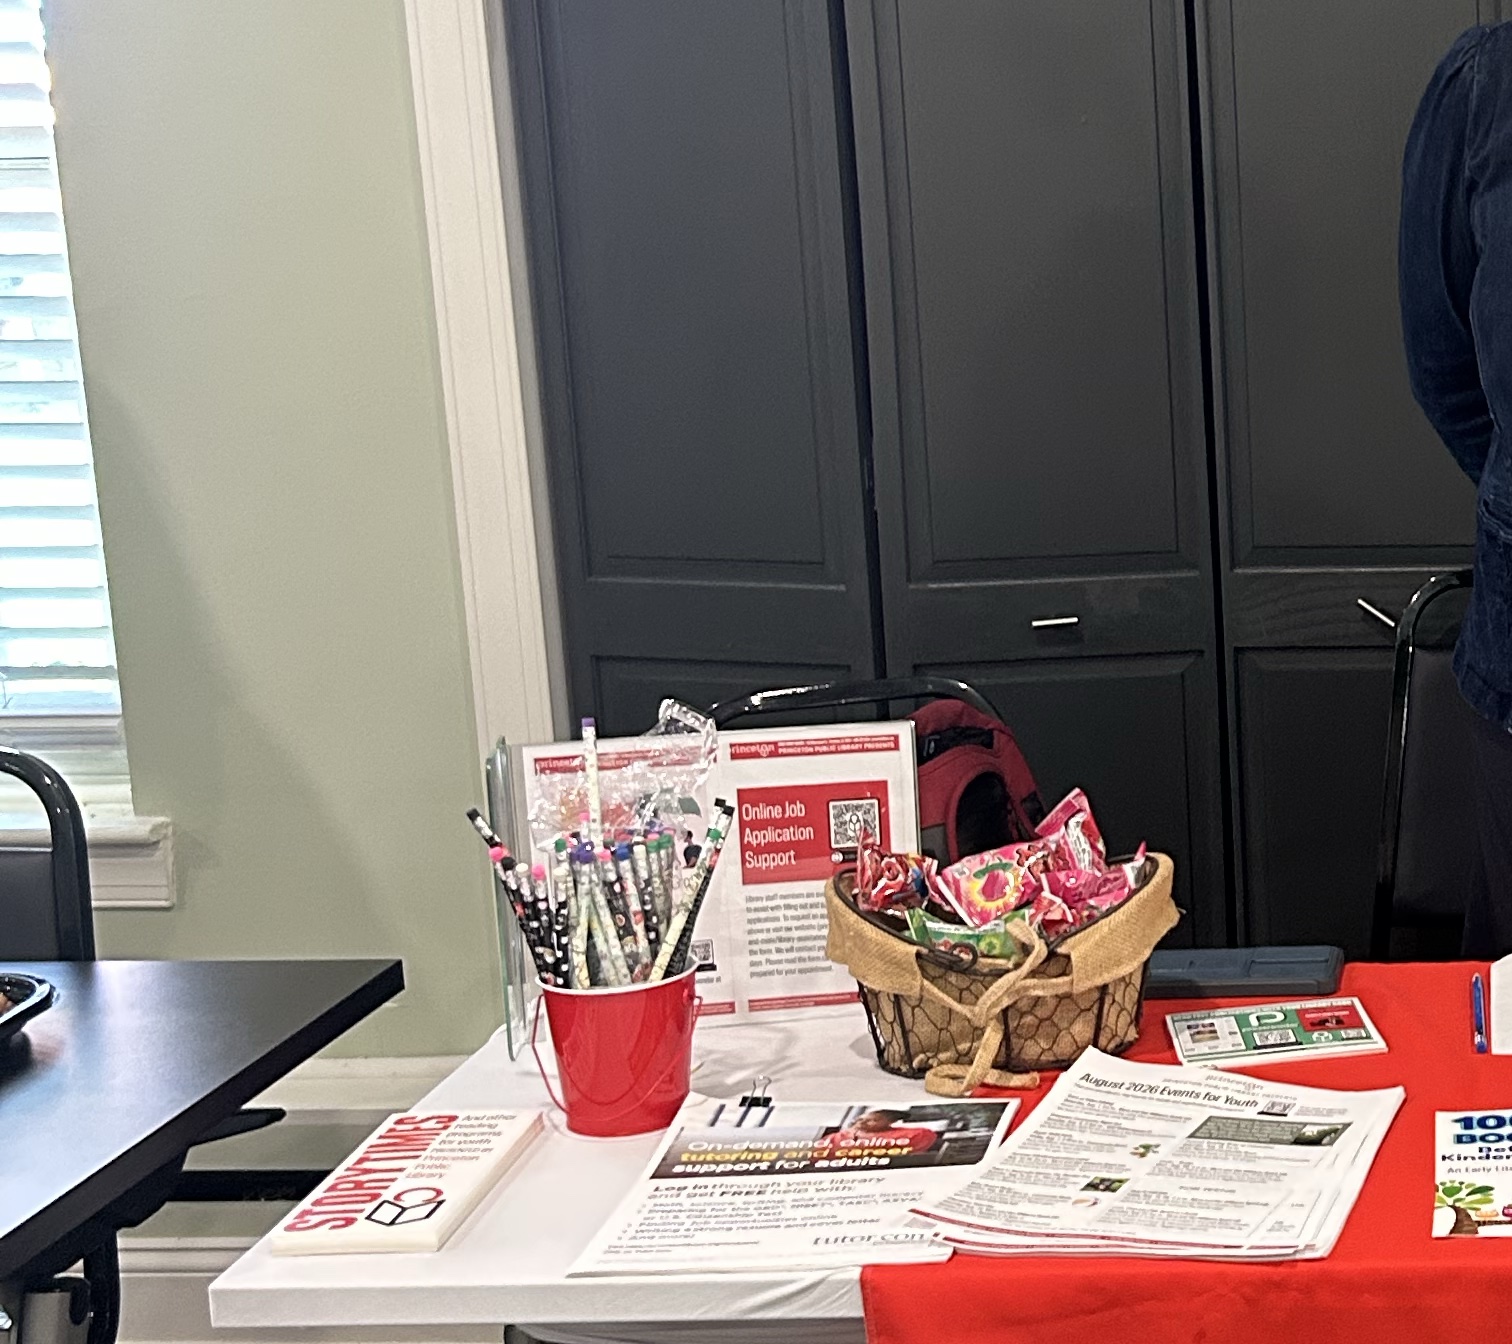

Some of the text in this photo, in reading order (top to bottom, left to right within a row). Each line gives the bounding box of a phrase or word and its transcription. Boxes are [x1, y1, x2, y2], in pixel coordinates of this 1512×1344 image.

[731, 743, 775, 757] rinceton
[742, 800, 805, 821] Online Job
[744, 826, 814, 845] Application
[745, 850, 796, 869] Support
[1079, 1073, 1125, 1091] August
[1159, 1086, 1201, 1100] Events
[1202, 1091, 1222, 1102] for
[1224, 1094, 1259, 1108] Youth
[688, 1136, 910, 1152] On-demand, online
[681, 1145, 913, 1163] tutoring and career
[284, 1115, 459, 1232] STORYTIMES
[672, 1156, 890, 1174] support for adults
[648, 1190, 682, 1199] and
[685, 1190, 716, 1199] get
[719, 1189, 766, 1197] FREE
[769, 1186, 809, 1196] help
[653, 1176, 886, 1194] Log in through your library
